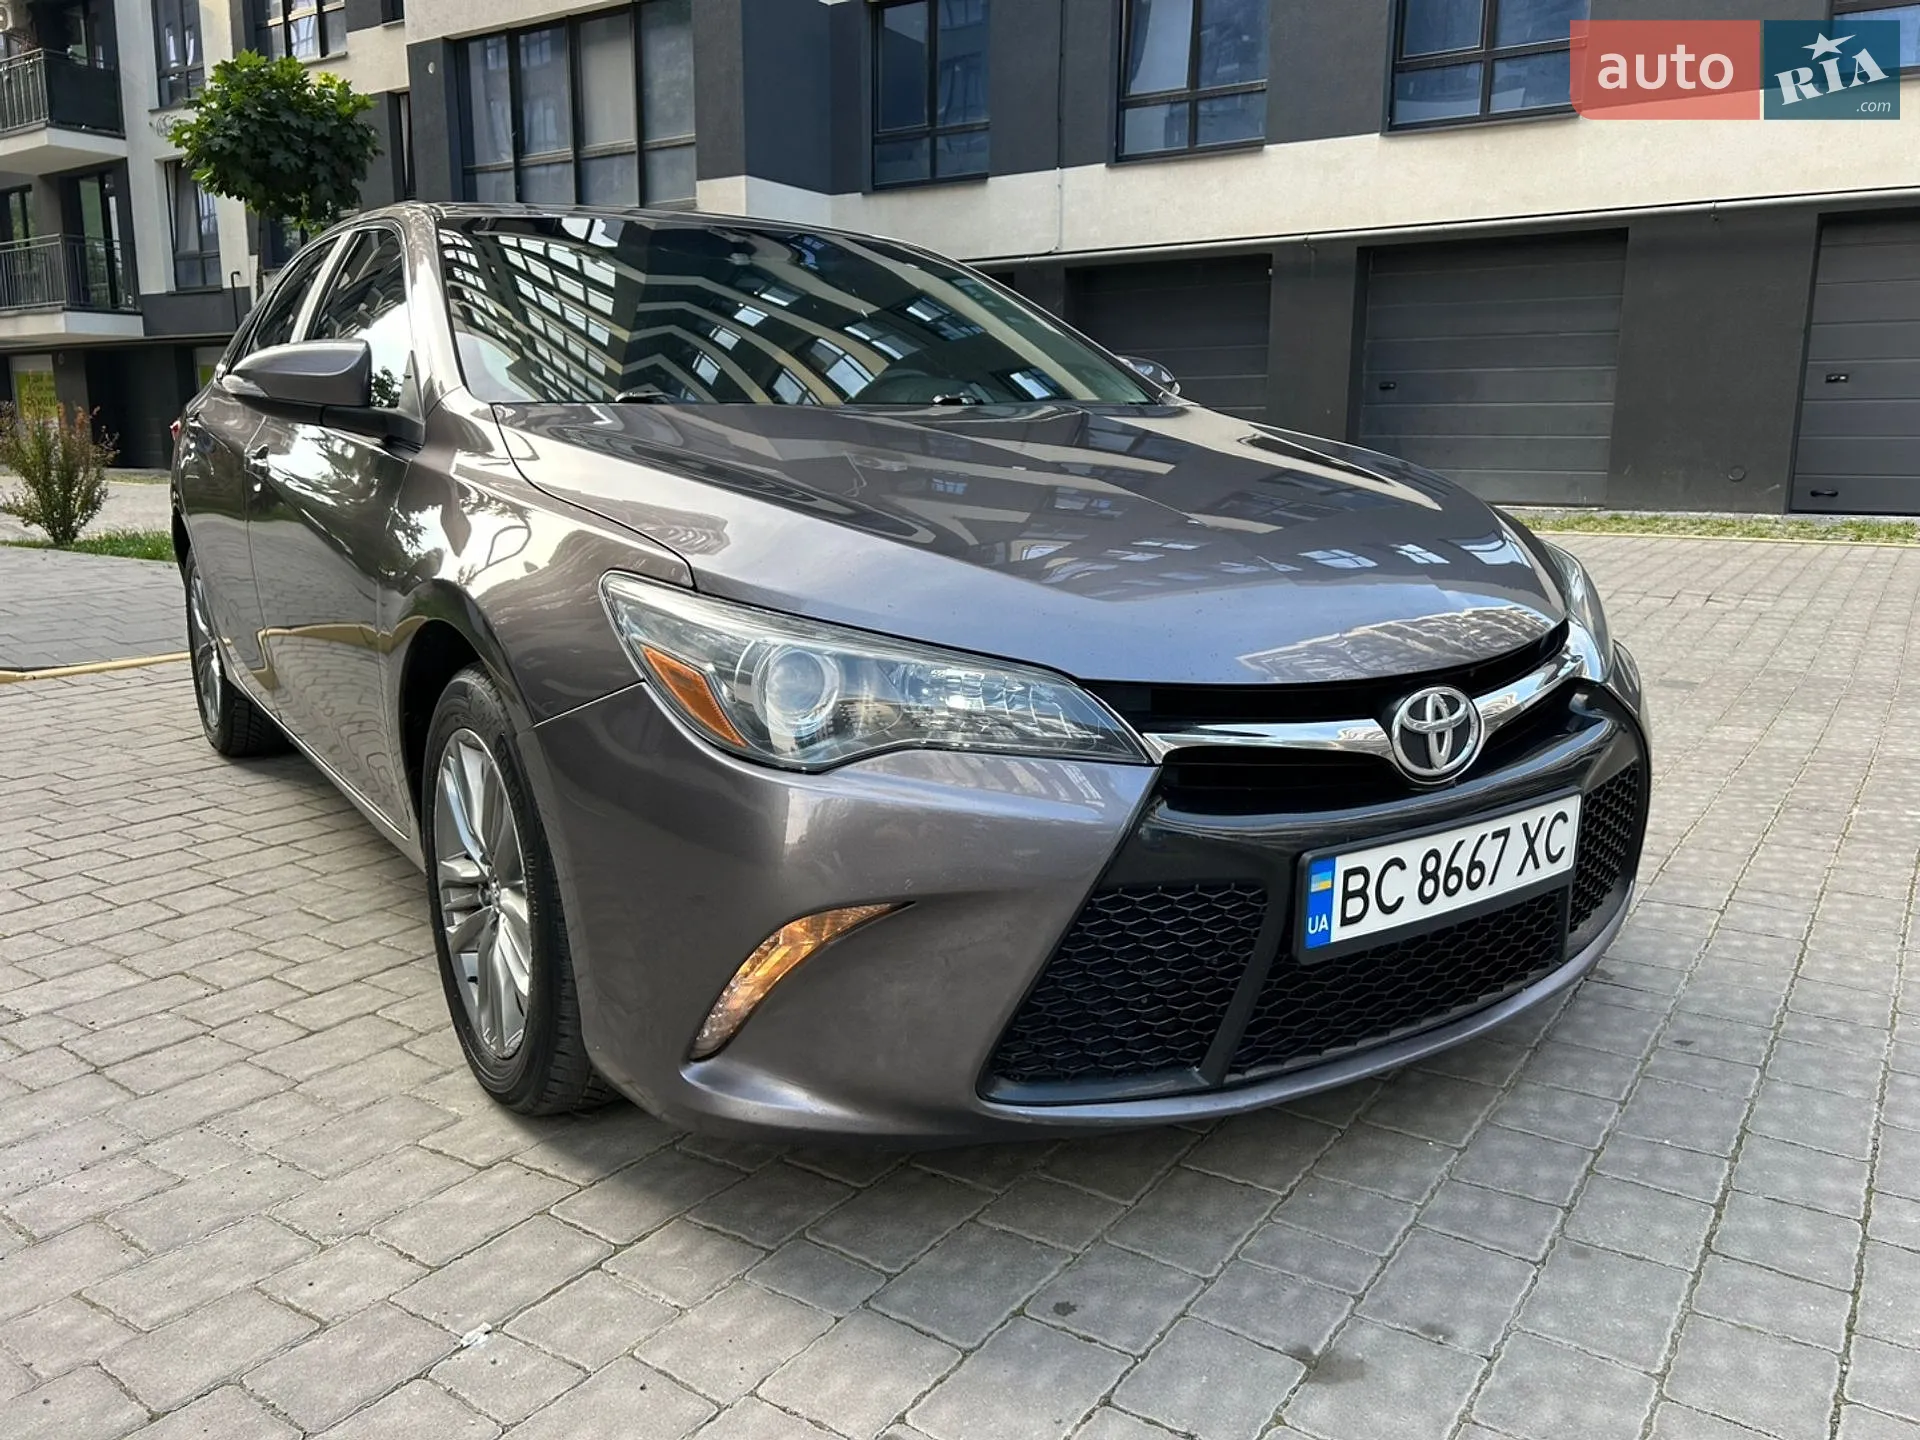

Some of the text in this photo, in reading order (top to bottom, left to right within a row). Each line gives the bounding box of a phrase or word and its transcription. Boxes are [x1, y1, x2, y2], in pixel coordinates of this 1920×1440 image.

[1340, 811, 1569, 927] BC 8667 XC
[1307, 913, 1329, 935] UA
